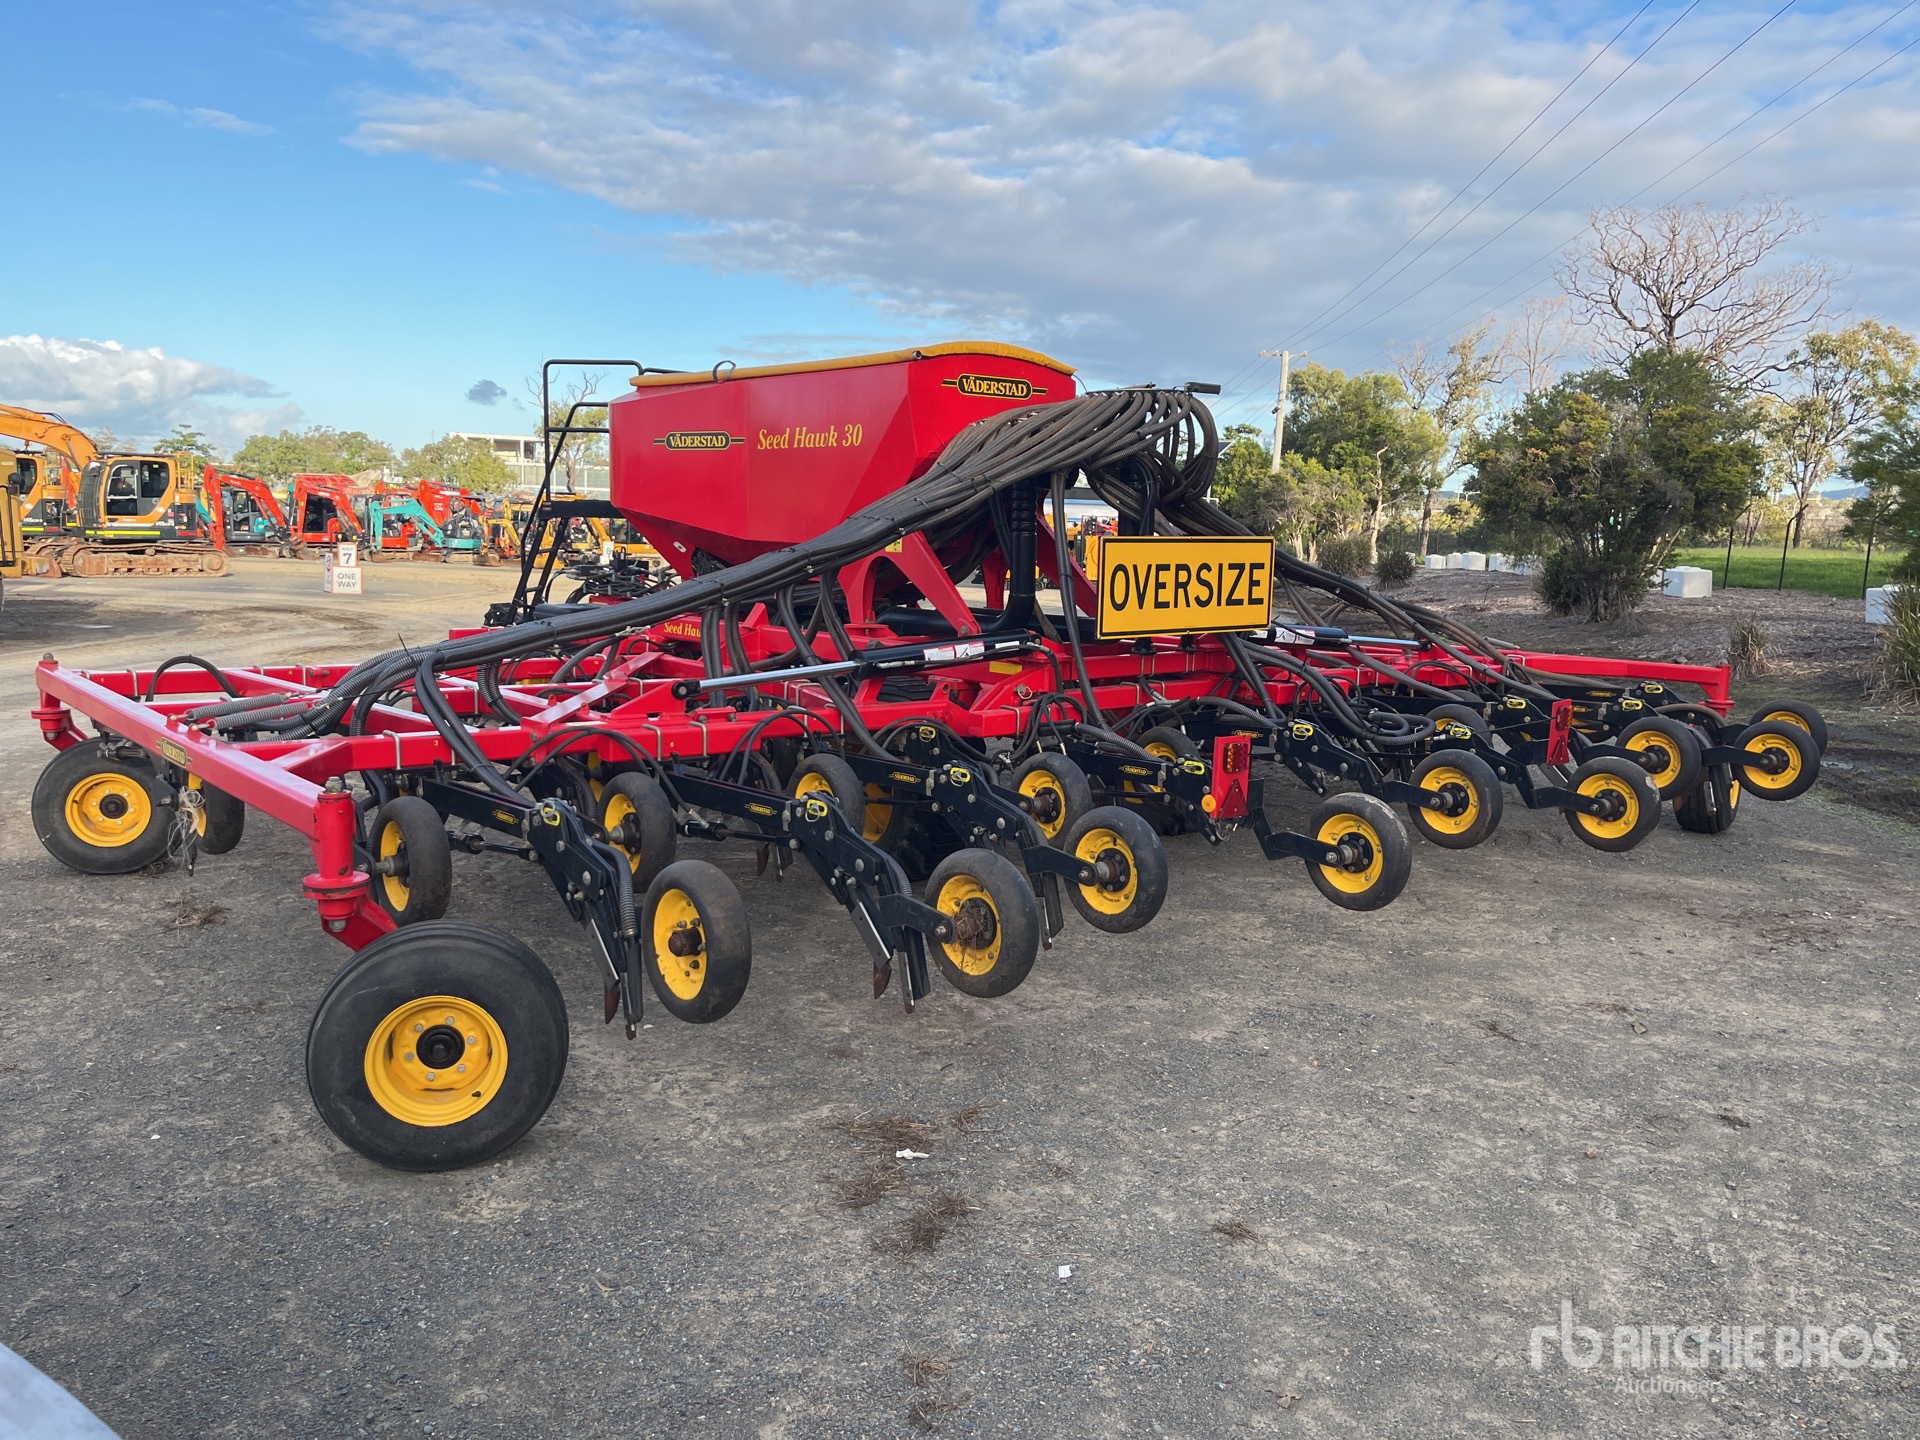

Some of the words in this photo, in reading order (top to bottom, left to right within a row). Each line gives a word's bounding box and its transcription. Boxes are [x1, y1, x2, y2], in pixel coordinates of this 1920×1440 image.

[962, 376, 1027, 397] VÄDERSTAD
[669, 433, 727, 448] VÄDERSTAD
[757, 427, 790, 450] Seed
[793, 424, 838, 448] Hawk
[842, 423, 863, 447] 30
[342, 552, 353, 565] 7
[337, 572, 357, 580] ONE
[1109, 562, 1266, 612] OVERSIZE
[663, 621, 683, 635] Seed
